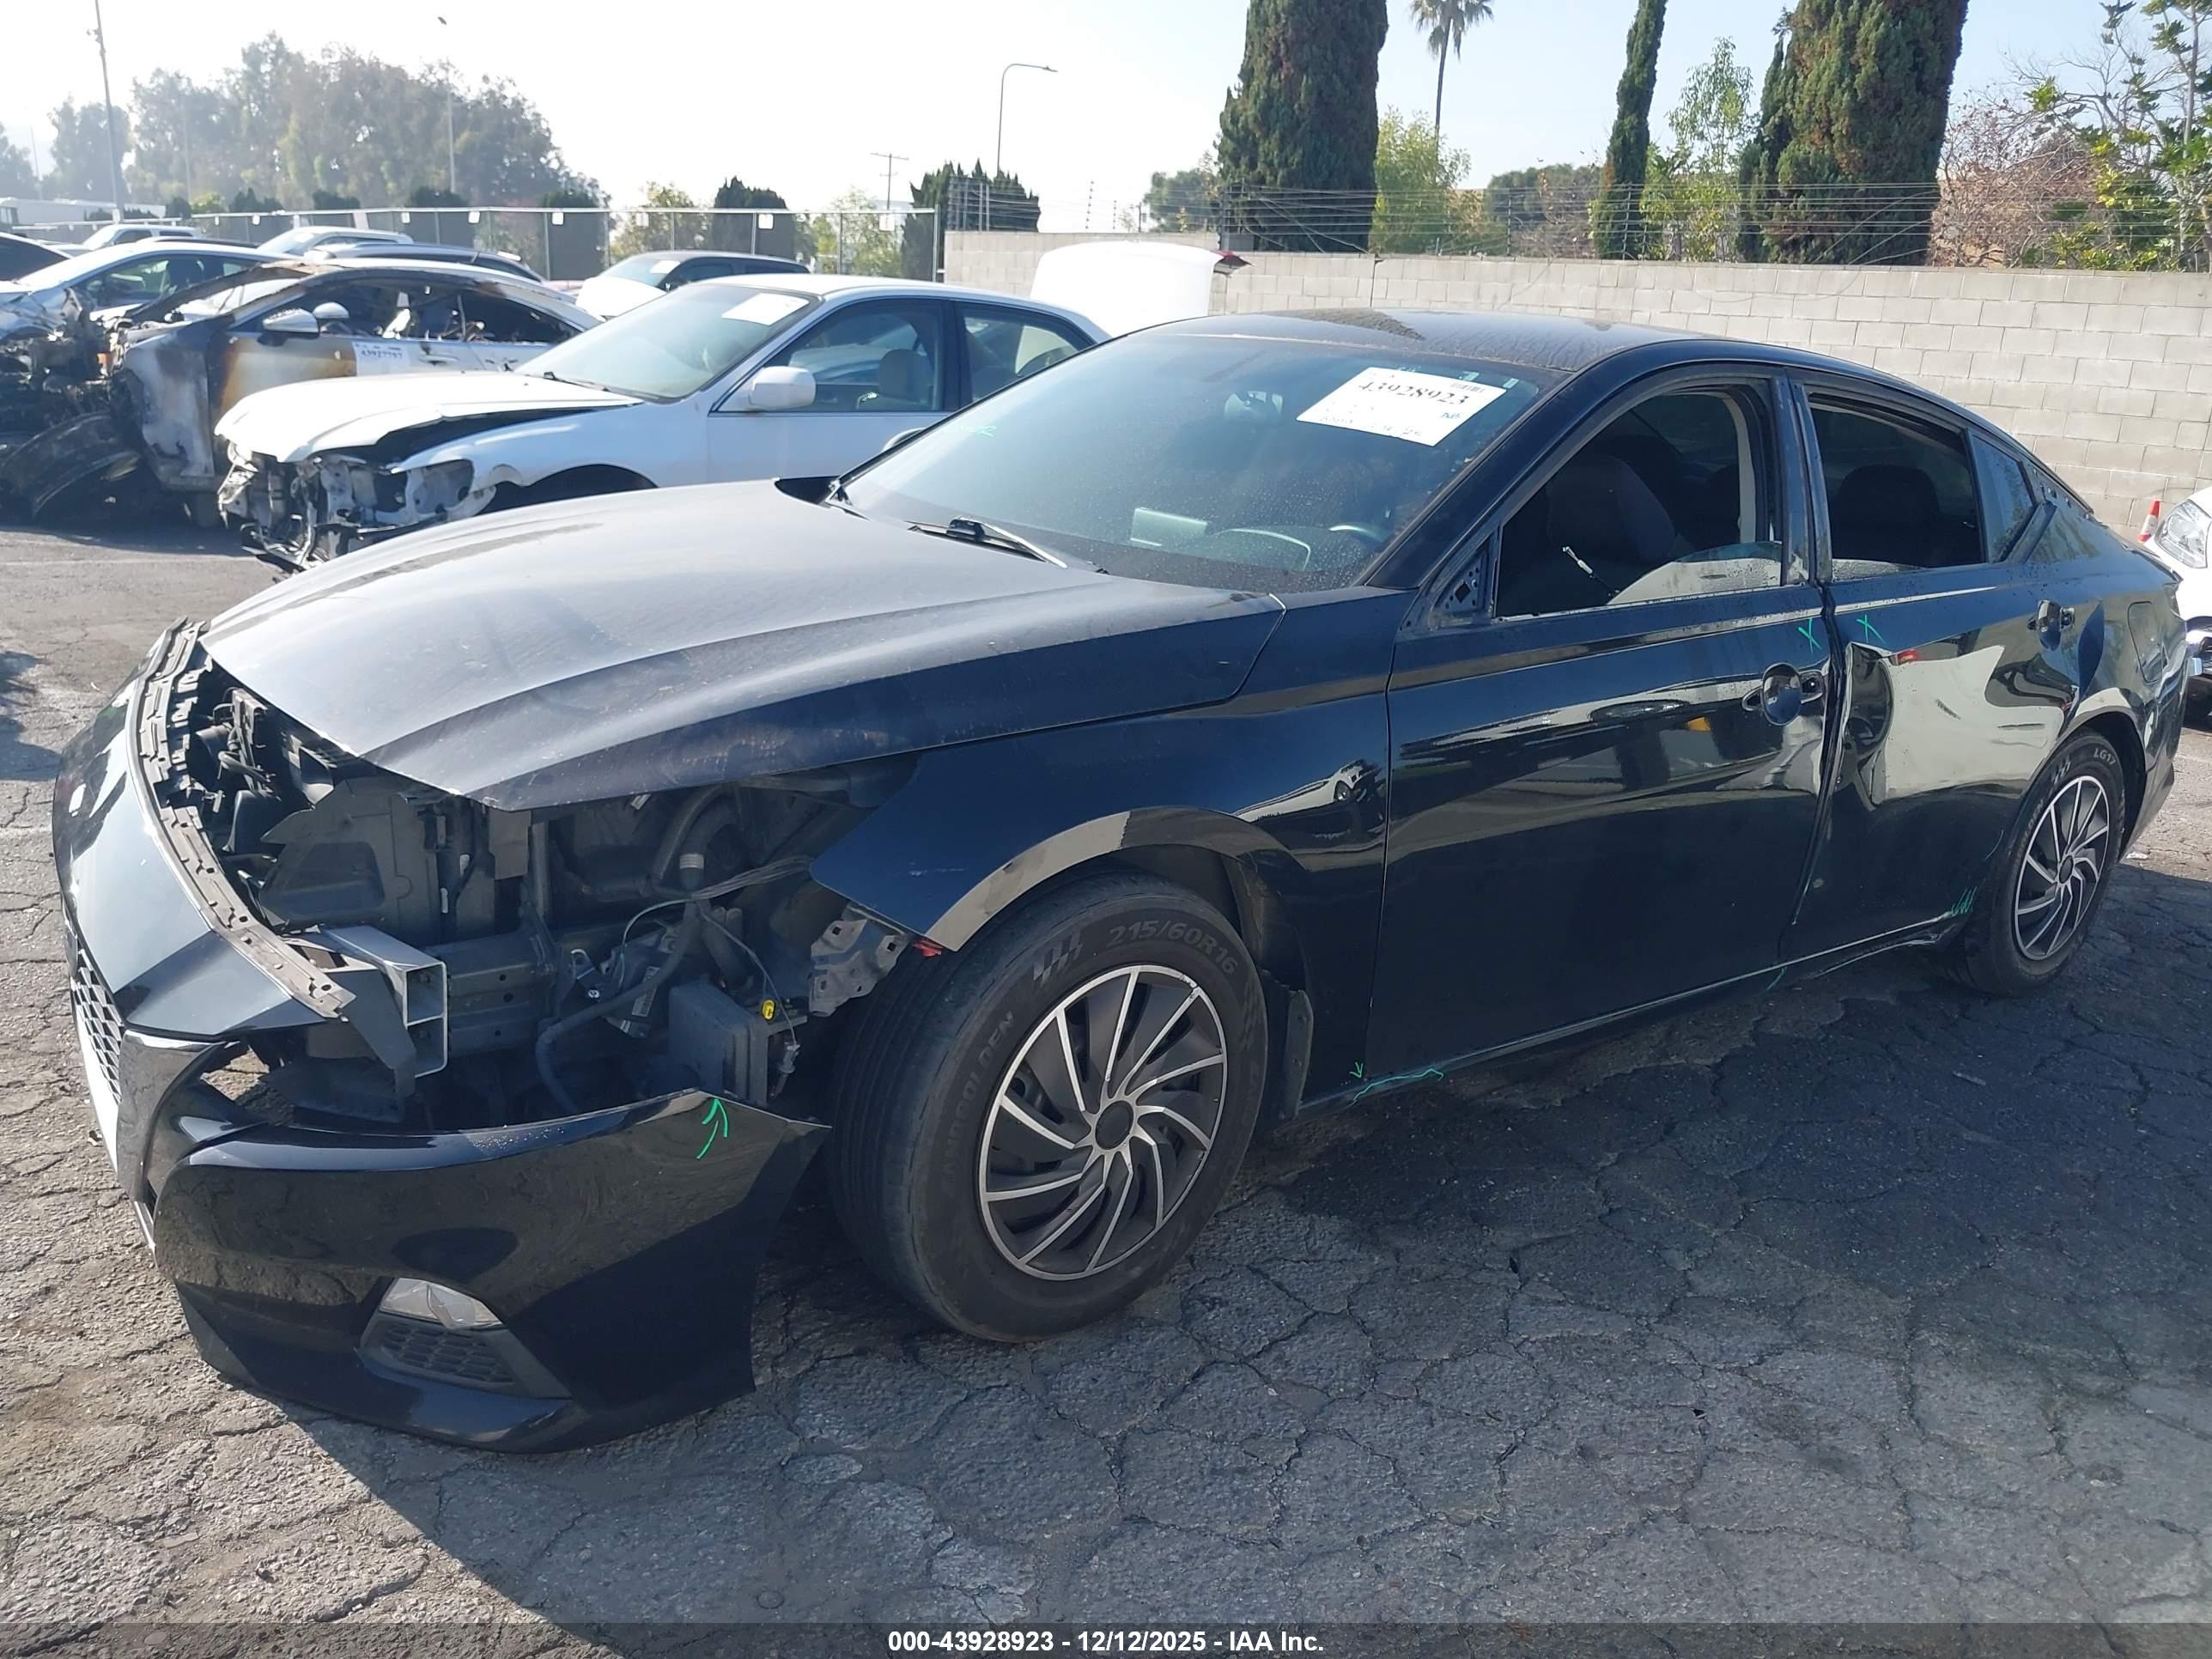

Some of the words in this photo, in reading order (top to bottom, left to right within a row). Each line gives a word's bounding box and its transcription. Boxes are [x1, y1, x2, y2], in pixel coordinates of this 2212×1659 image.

[1358, 381, 1470, 405] 43928923
[2093, 747, 2117, 766] LG17
[1108, 920, 1238, 975] 215/60R16
